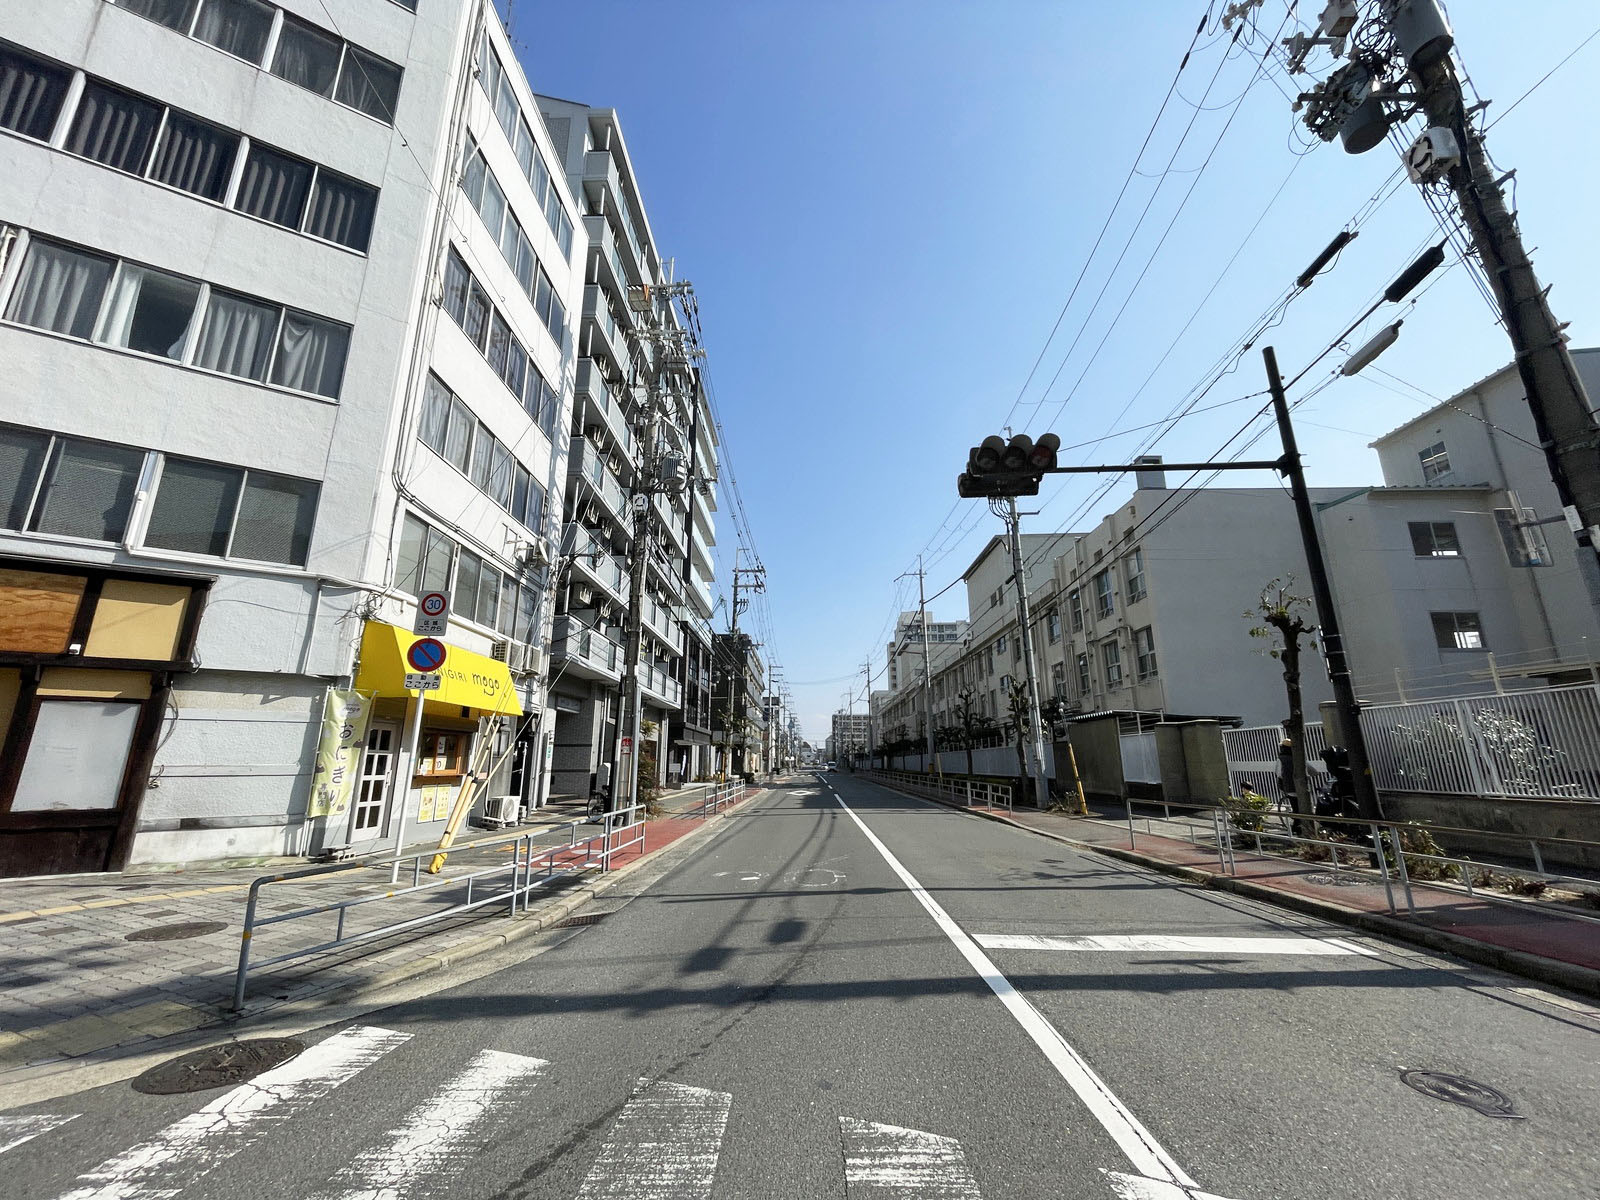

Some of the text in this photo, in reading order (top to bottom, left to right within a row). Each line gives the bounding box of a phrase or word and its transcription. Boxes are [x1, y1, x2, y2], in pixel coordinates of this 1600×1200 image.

[427, 599, 441, 610] 30
[405, 680, 439, 689] ここから
[472, 672, 500, 696] mogo
